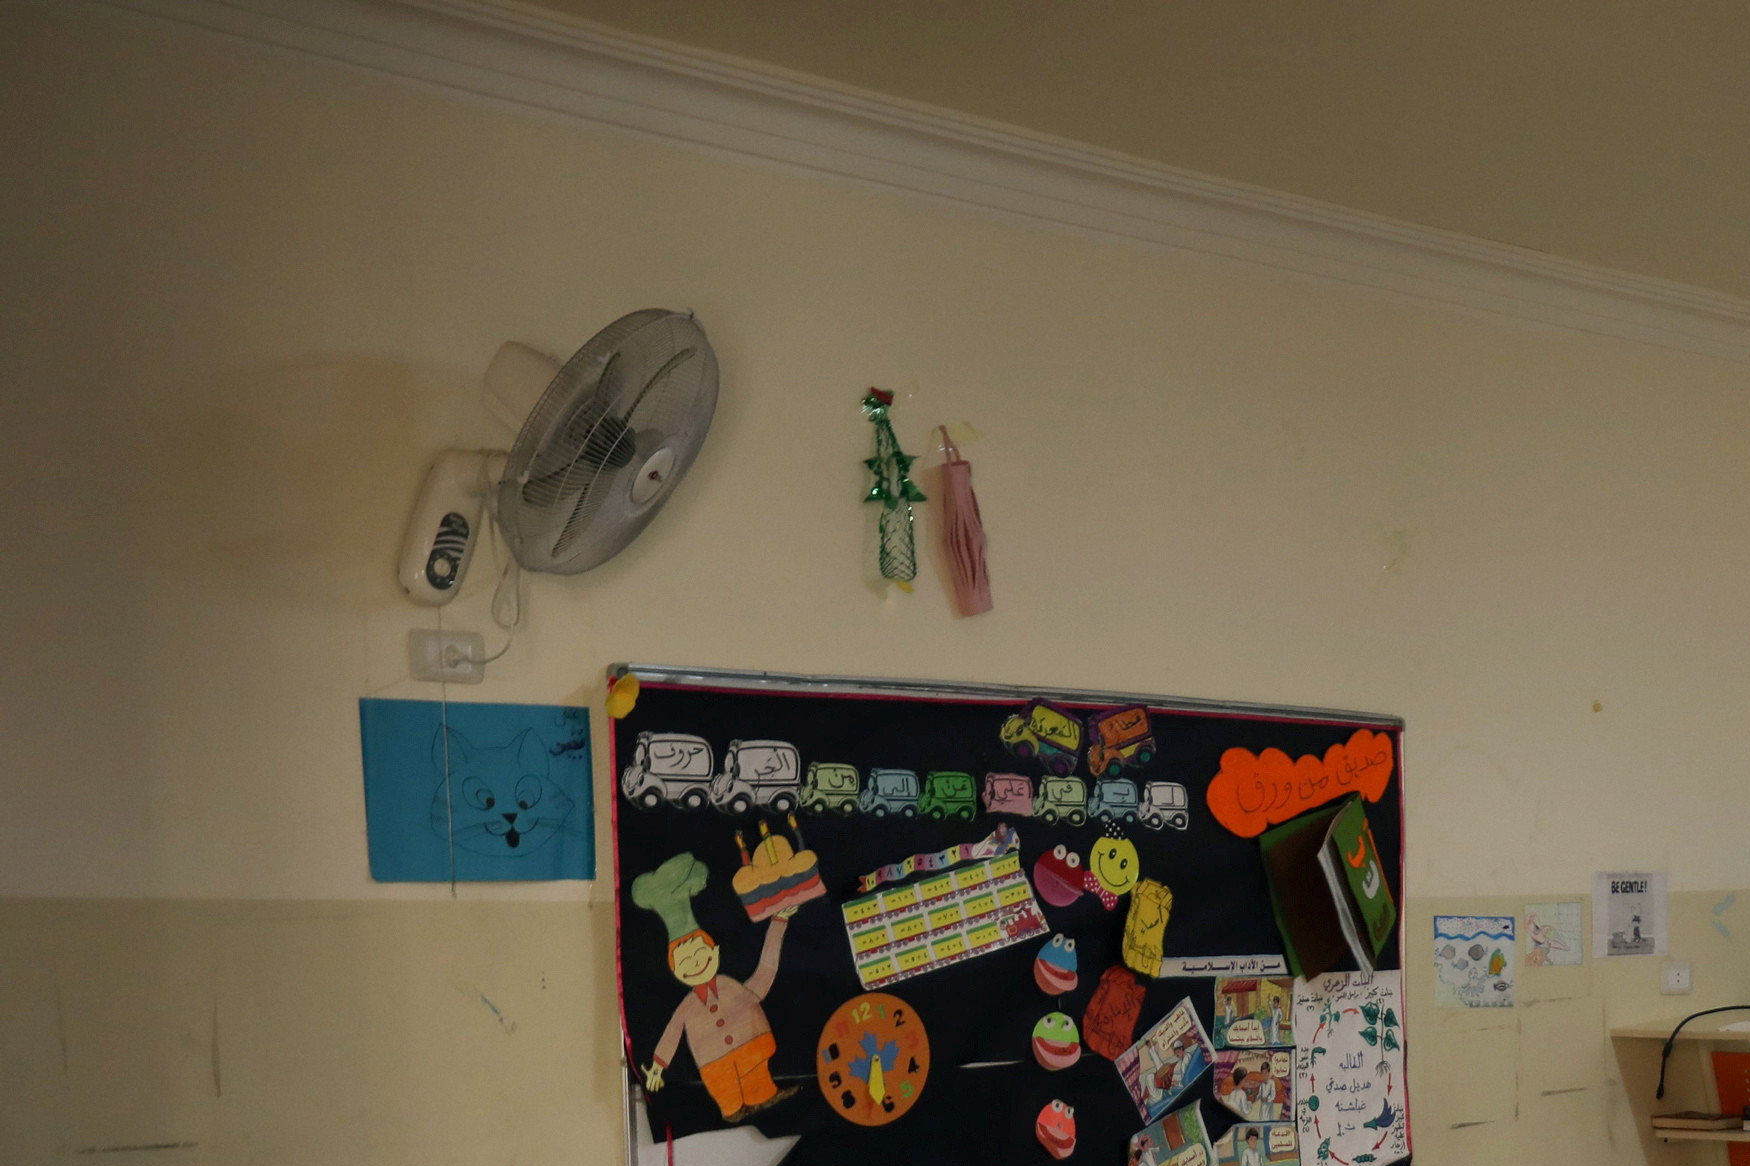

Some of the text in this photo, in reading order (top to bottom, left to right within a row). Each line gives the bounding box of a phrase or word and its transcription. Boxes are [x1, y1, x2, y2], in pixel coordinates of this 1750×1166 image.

[1611, 880, 1648, 894] BE GENTLE!
[1182, 960, 1238, 974] الإسلامية
[852, 1002, 873, 1024] 12
[893, 1009, 906, 1027] 2
[908, 1056, 920, 1074] 4
[900, 1080, 914, 1098] 5
